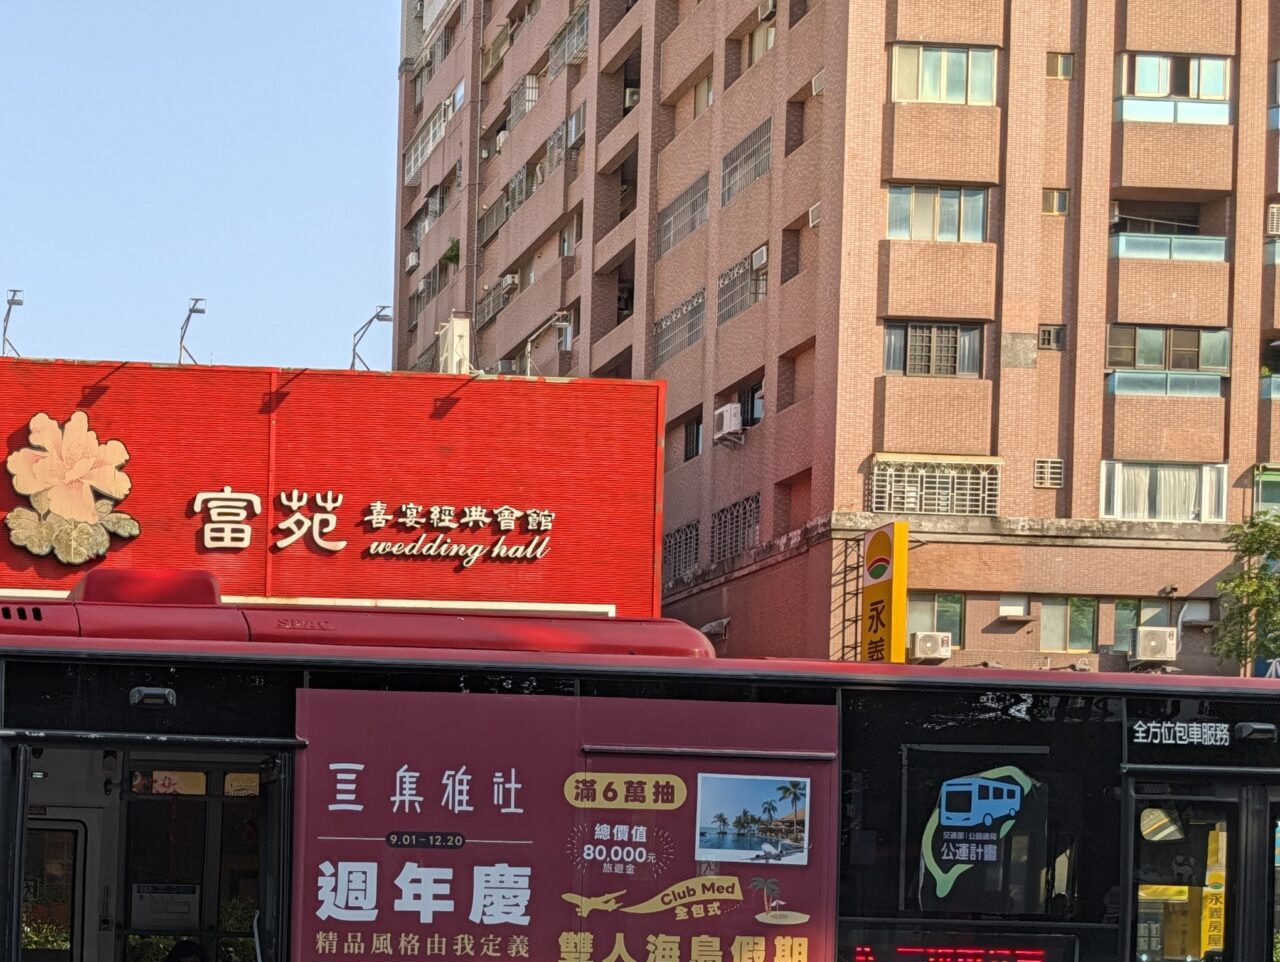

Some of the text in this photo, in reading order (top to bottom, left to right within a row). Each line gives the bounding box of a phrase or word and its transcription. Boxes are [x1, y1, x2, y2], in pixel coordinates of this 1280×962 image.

[193, 486, 347, 551] 富苑
[364, 501, 556, 531] 喜宴經典會館
[370, 533, 551, 567] wedding hall
[1132, 720, 1231, 747] 全方位包車服務
[574, 779, 676, 804] 滿6萬抽
[594, 823, 648, 843] 總價值
[602, 863, 636, 875] 旅遊金
[315, 860, 532, 926] 週年慶
[660, 882, 736, 906] Club Med
[675, 902, 722, 921] 全包式
[315, 930, 530, 958] 精品風格由我定義
